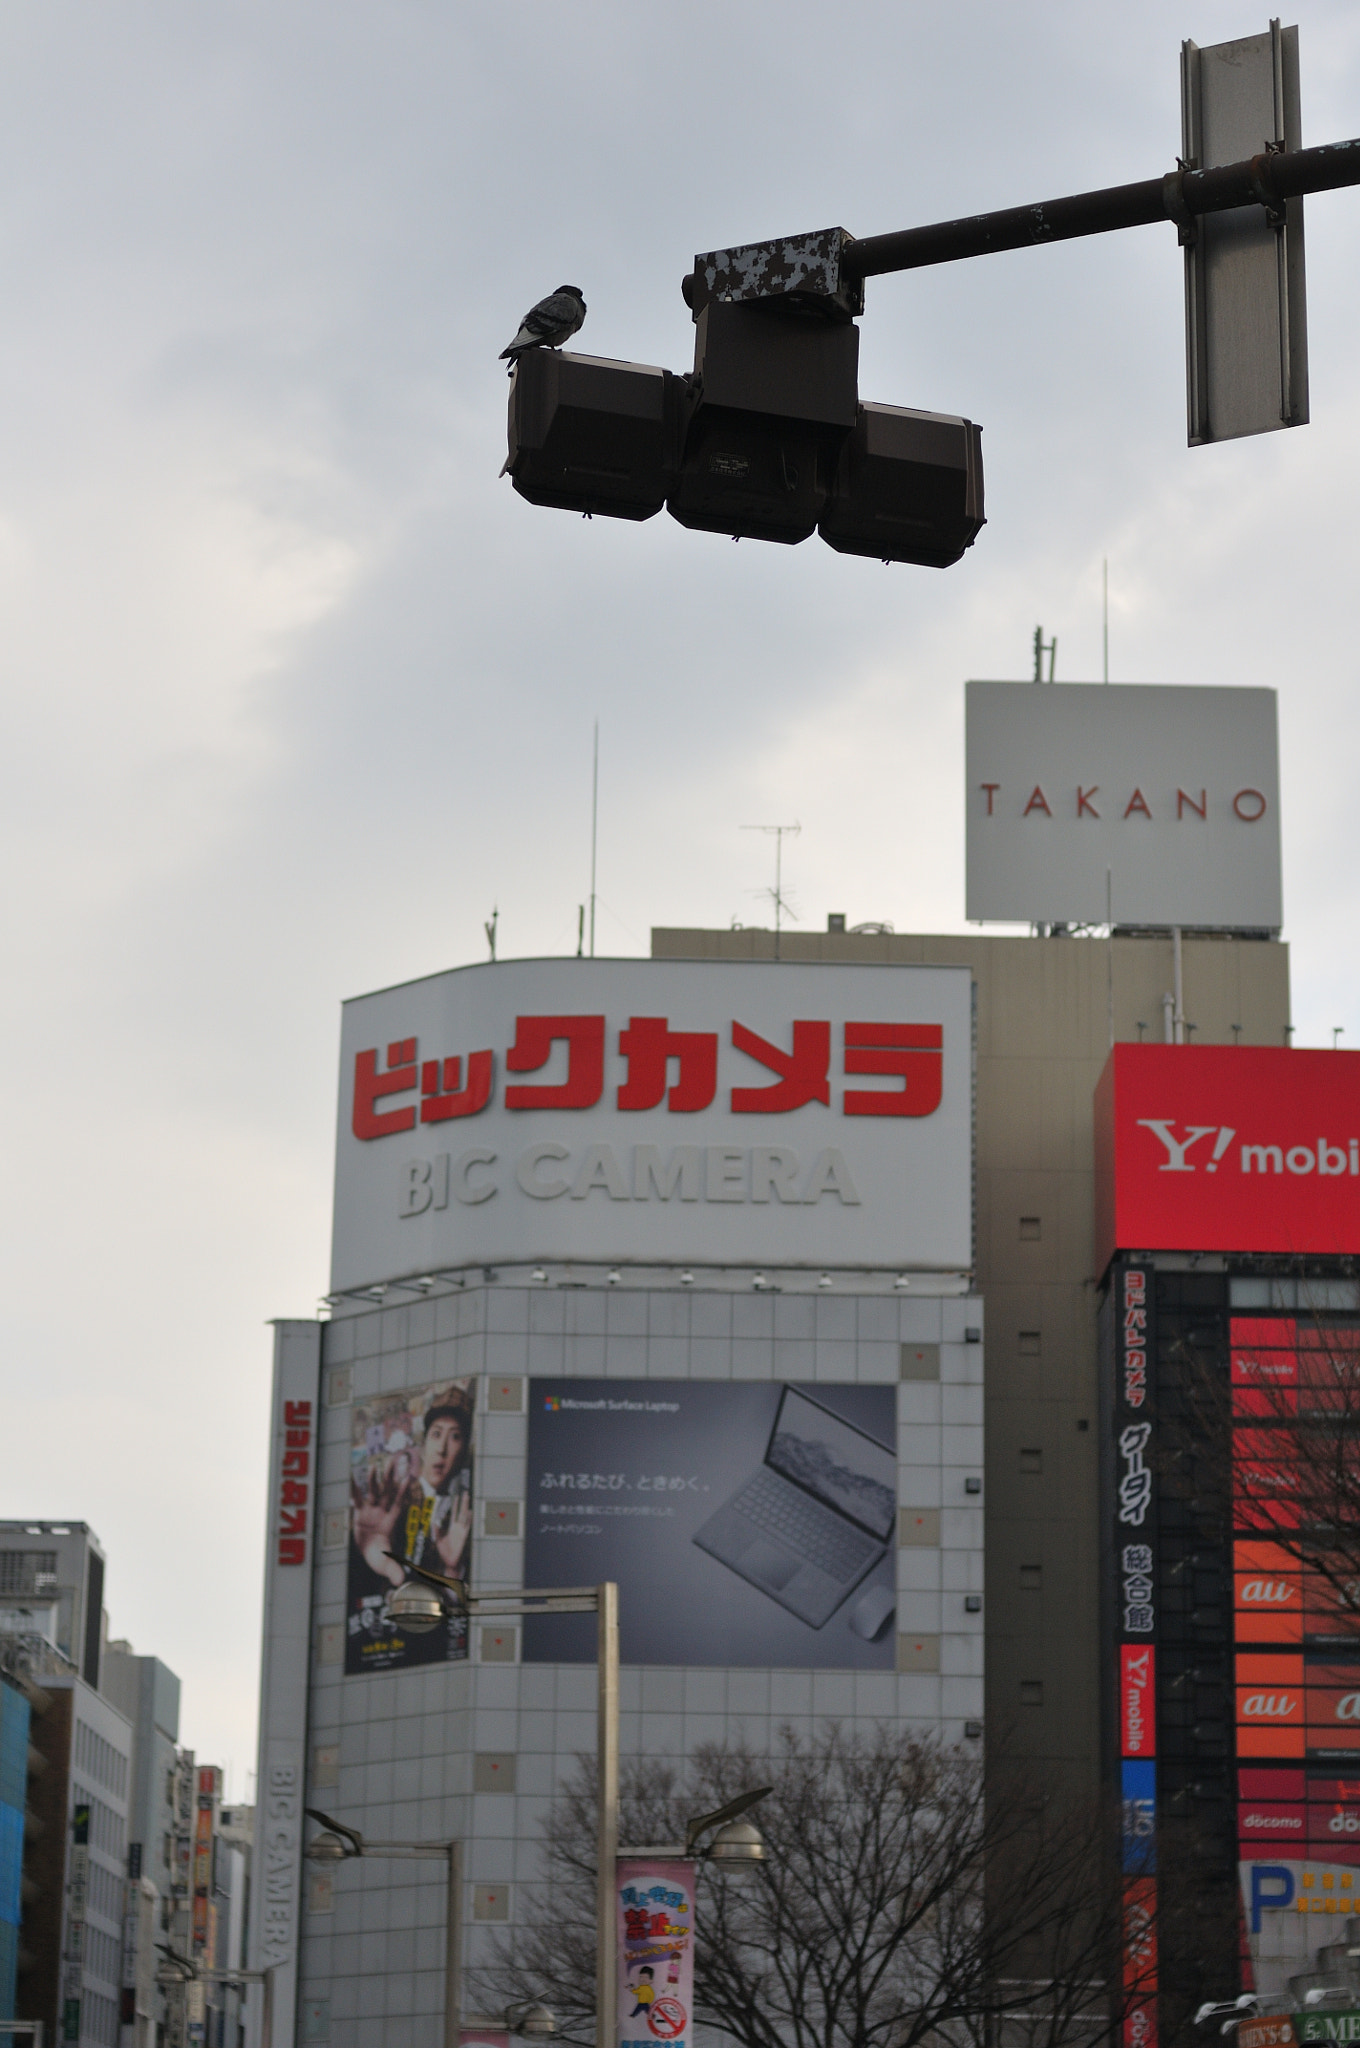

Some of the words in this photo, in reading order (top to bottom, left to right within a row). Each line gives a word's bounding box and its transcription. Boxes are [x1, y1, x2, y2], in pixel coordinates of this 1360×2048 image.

[981, 784, 1267, 822] TAKANO
[352, 1014, 944, 1141] ビックカメラ
[400, 1146, 499, 1219] BIC
[516, 1142, 861, 1206] CAMERA
[1125, 1271, 1146, 1408] ヨドバシカメラ
[561, 1398, 606, 1410] Microsoft
[608, 1400, 643, 1411] Surface
[645, 1401, 680, 1413] Laptop
[278, 1400, 311, 1566] ビックカメラ
[1241, 1580, 1295, 1602] au
[1242, 1693, 1296, 1718] au
[1243, 1813, 1302, 1829] docomo
[1251, 1866, 1295, 1934] P
